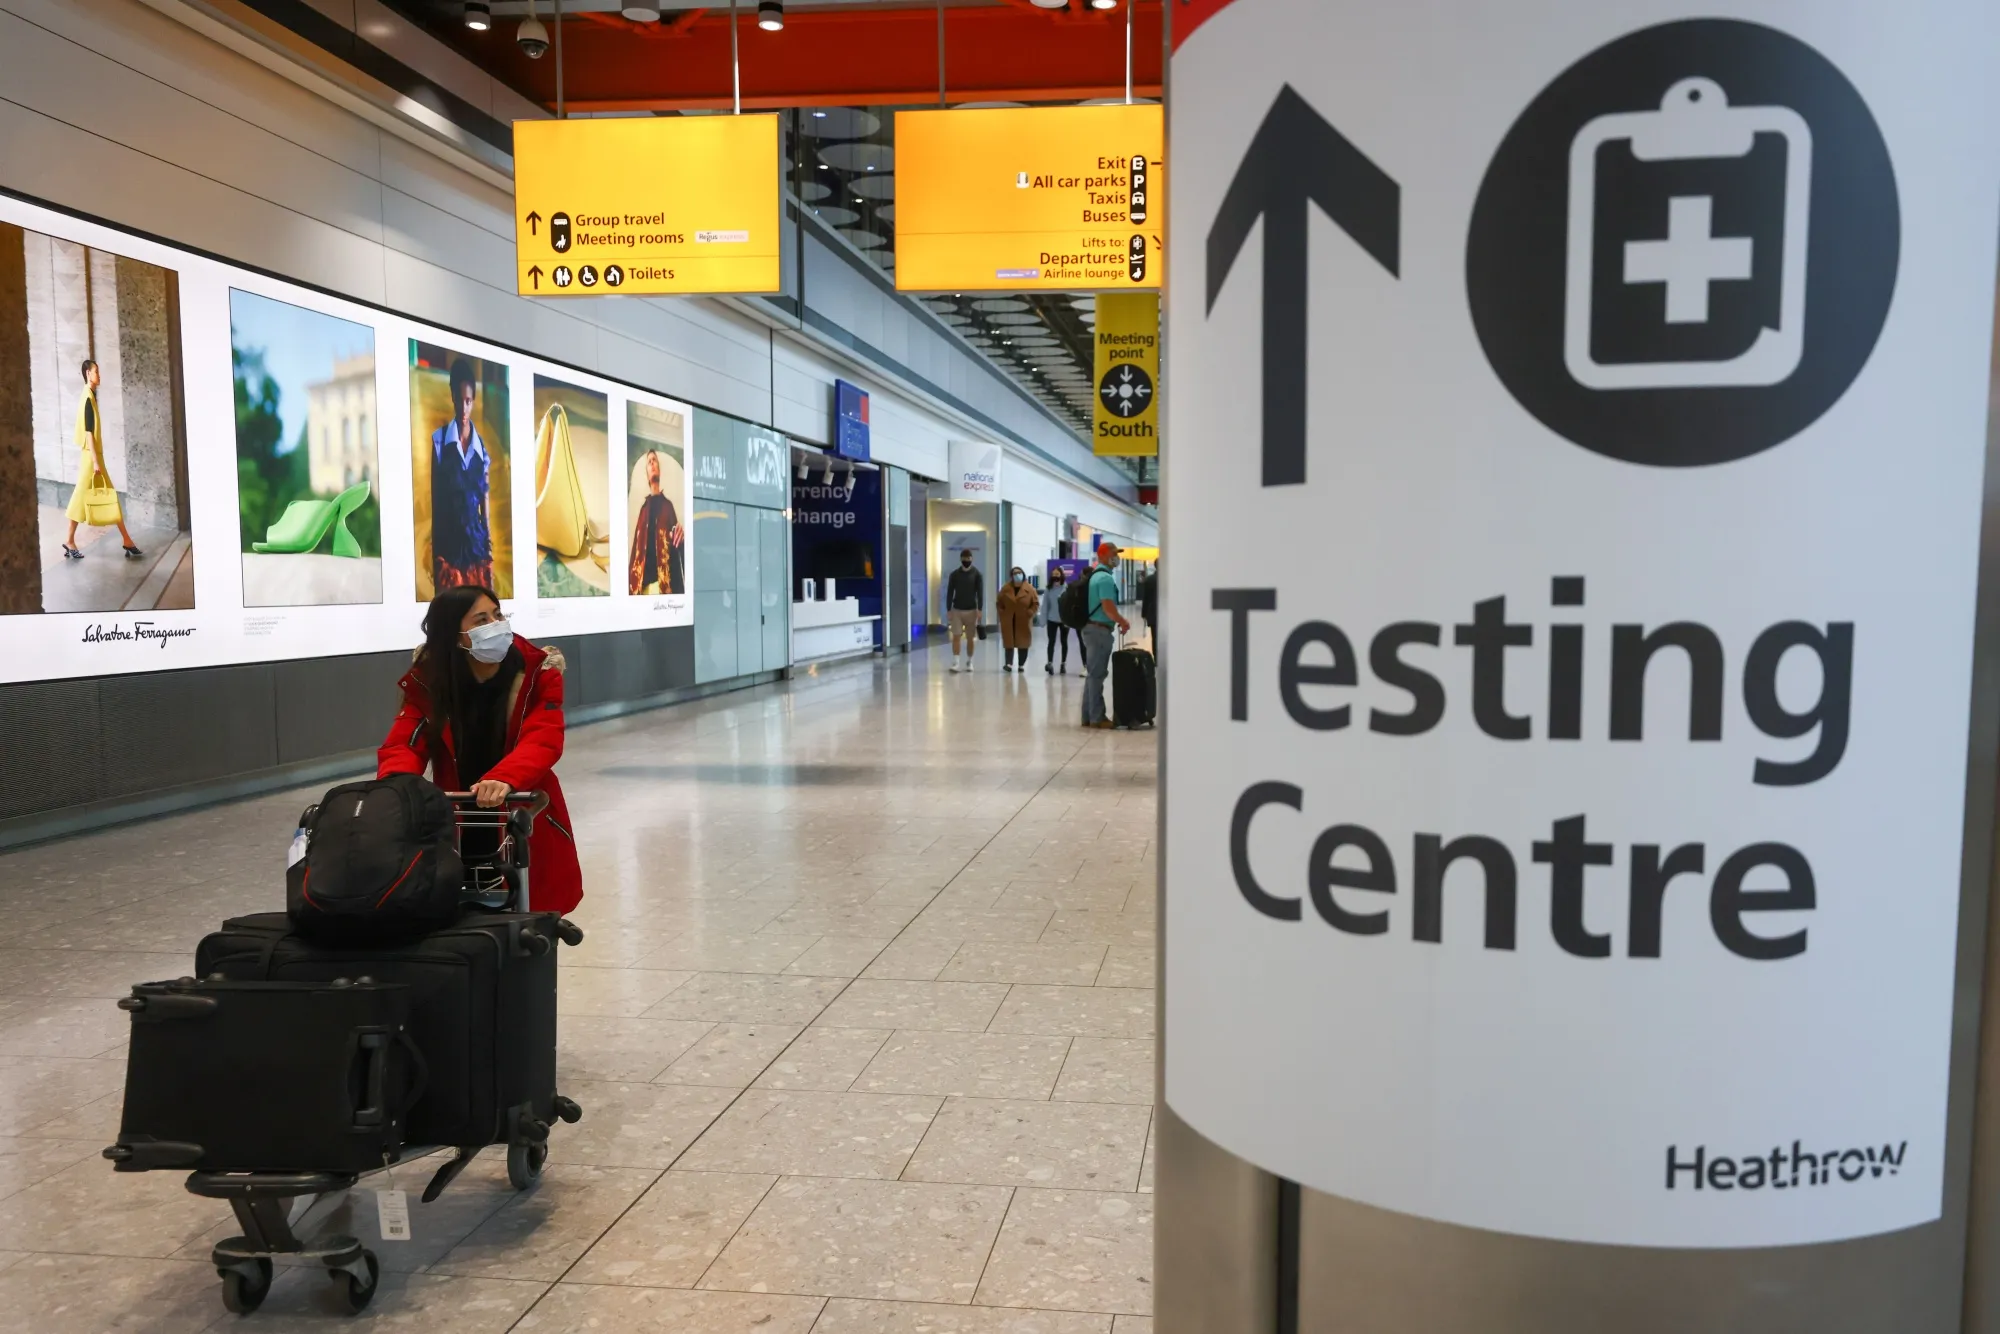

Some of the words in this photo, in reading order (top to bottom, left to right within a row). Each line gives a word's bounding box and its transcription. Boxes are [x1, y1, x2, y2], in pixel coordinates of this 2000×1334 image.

[1098, 156, 1126, 170] Exit
[1033, 175, 1053, 188] All
[1058, 178, 1080, 188] car
[1085, 174, 1126, 190] parks
[1088, 191, 1126, 204] Taxis
[576, 213, 620, 228] Group
[624, 212, 665, 226] travel
[1083, 210, 1126, 222] Buses
[577, 232, 635, 247] Meeting
[639, 234, 684, 245] rooms
[1082, 237, 1106, 248] Lifts
[1109, 238, 1125, 247] to:
[1040, 252, 1125, 267] Departures
[628, 267, 675, 280] Toilets
[1044, 269, 1081, 279] Airline
[1085, 268, 1125, 280] lounge
[1099, 332, 1154, 348] Meeting
[1109, 347, 1144, 361] point
[1098, 421, 1154, 437] South
[963, 472, 994, 483] national
[963, 481, 994, 492] express
[82, 623, 133, 643] Salvatore
[134, 622, 196, 649] Ferragamo
[1210, 575, 1855, 787] Testing
[1229, 780, 1817, 961] Centre
[1665, 1139, 1908, 1192] Heathrow
